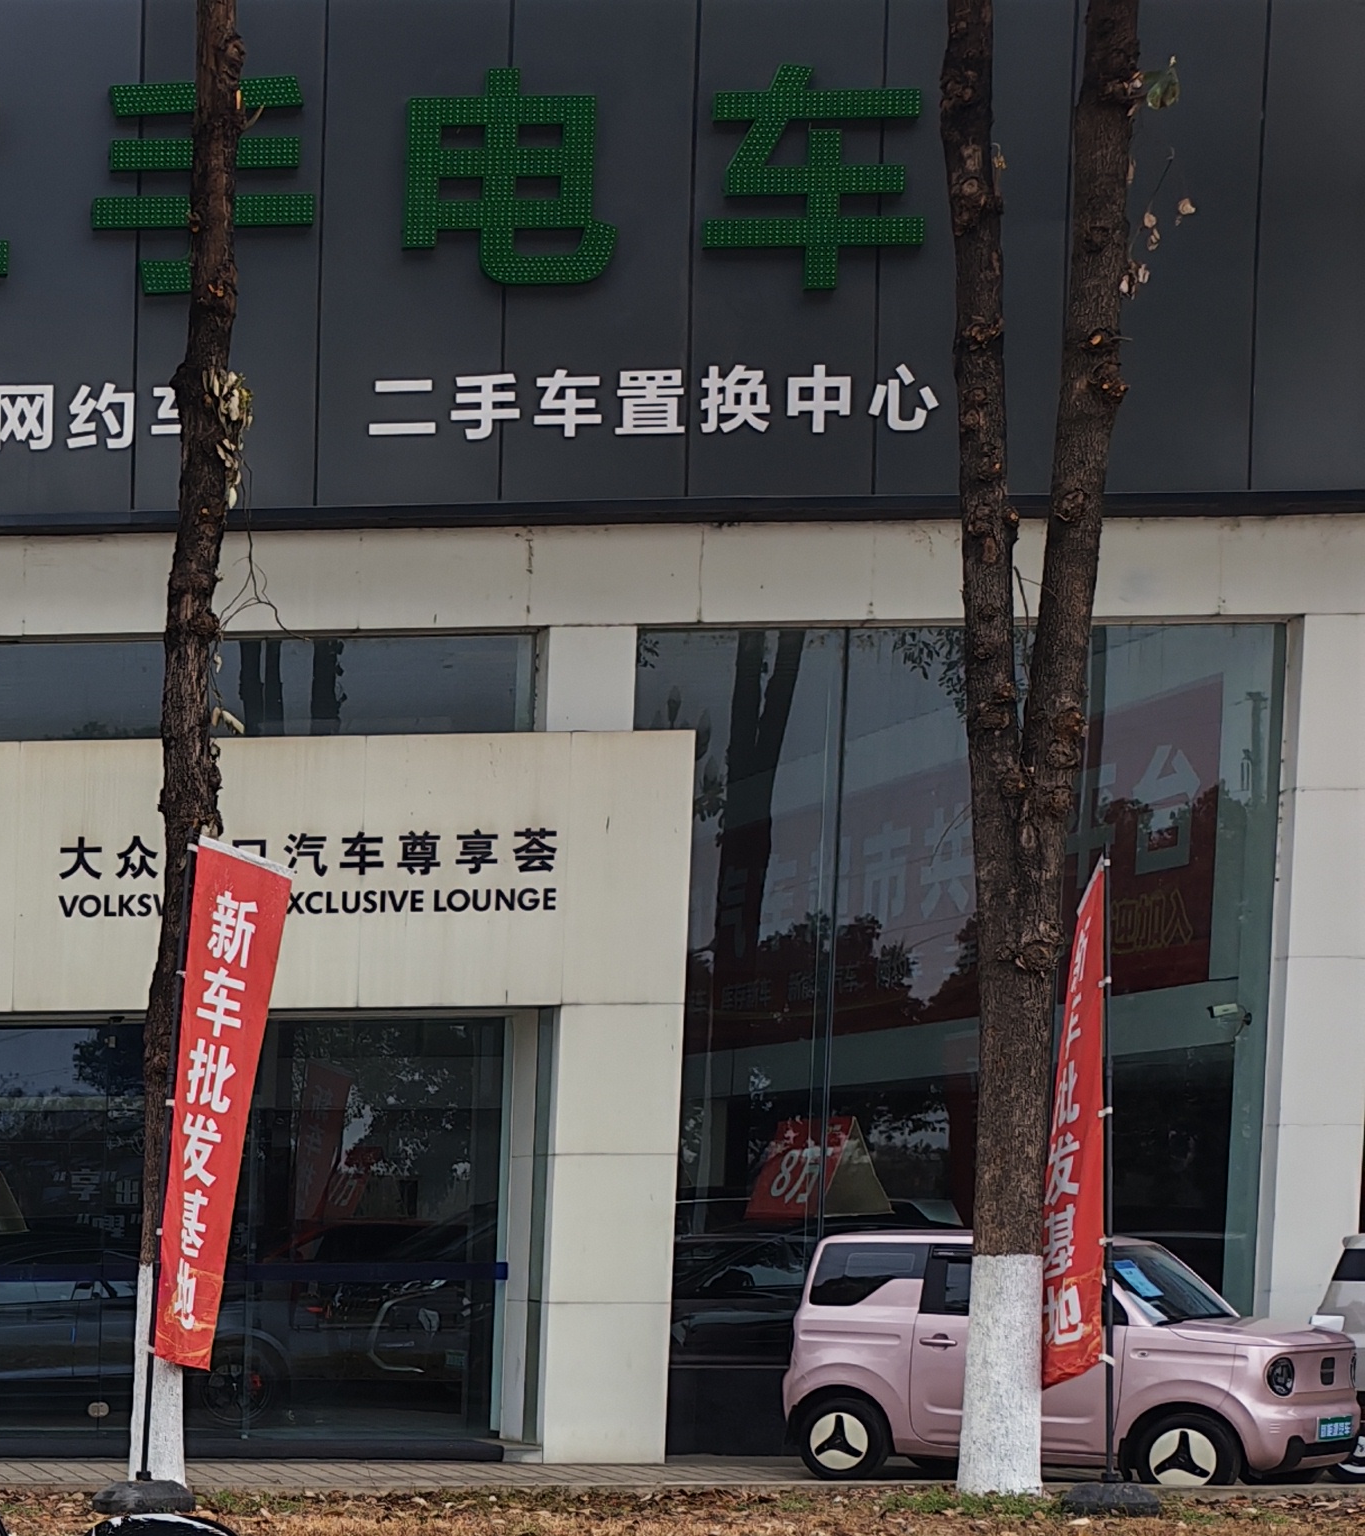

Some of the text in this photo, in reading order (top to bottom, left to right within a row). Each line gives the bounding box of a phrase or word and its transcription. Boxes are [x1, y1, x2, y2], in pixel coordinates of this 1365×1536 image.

[367, 362, 940, 441] 二手车置换中心
[58, 828, 558, 881] 大众汽车尊享荟
[432, 887, 558, 912] LOUNGE
[171, 889, 259, 1331] 新车批发基地
